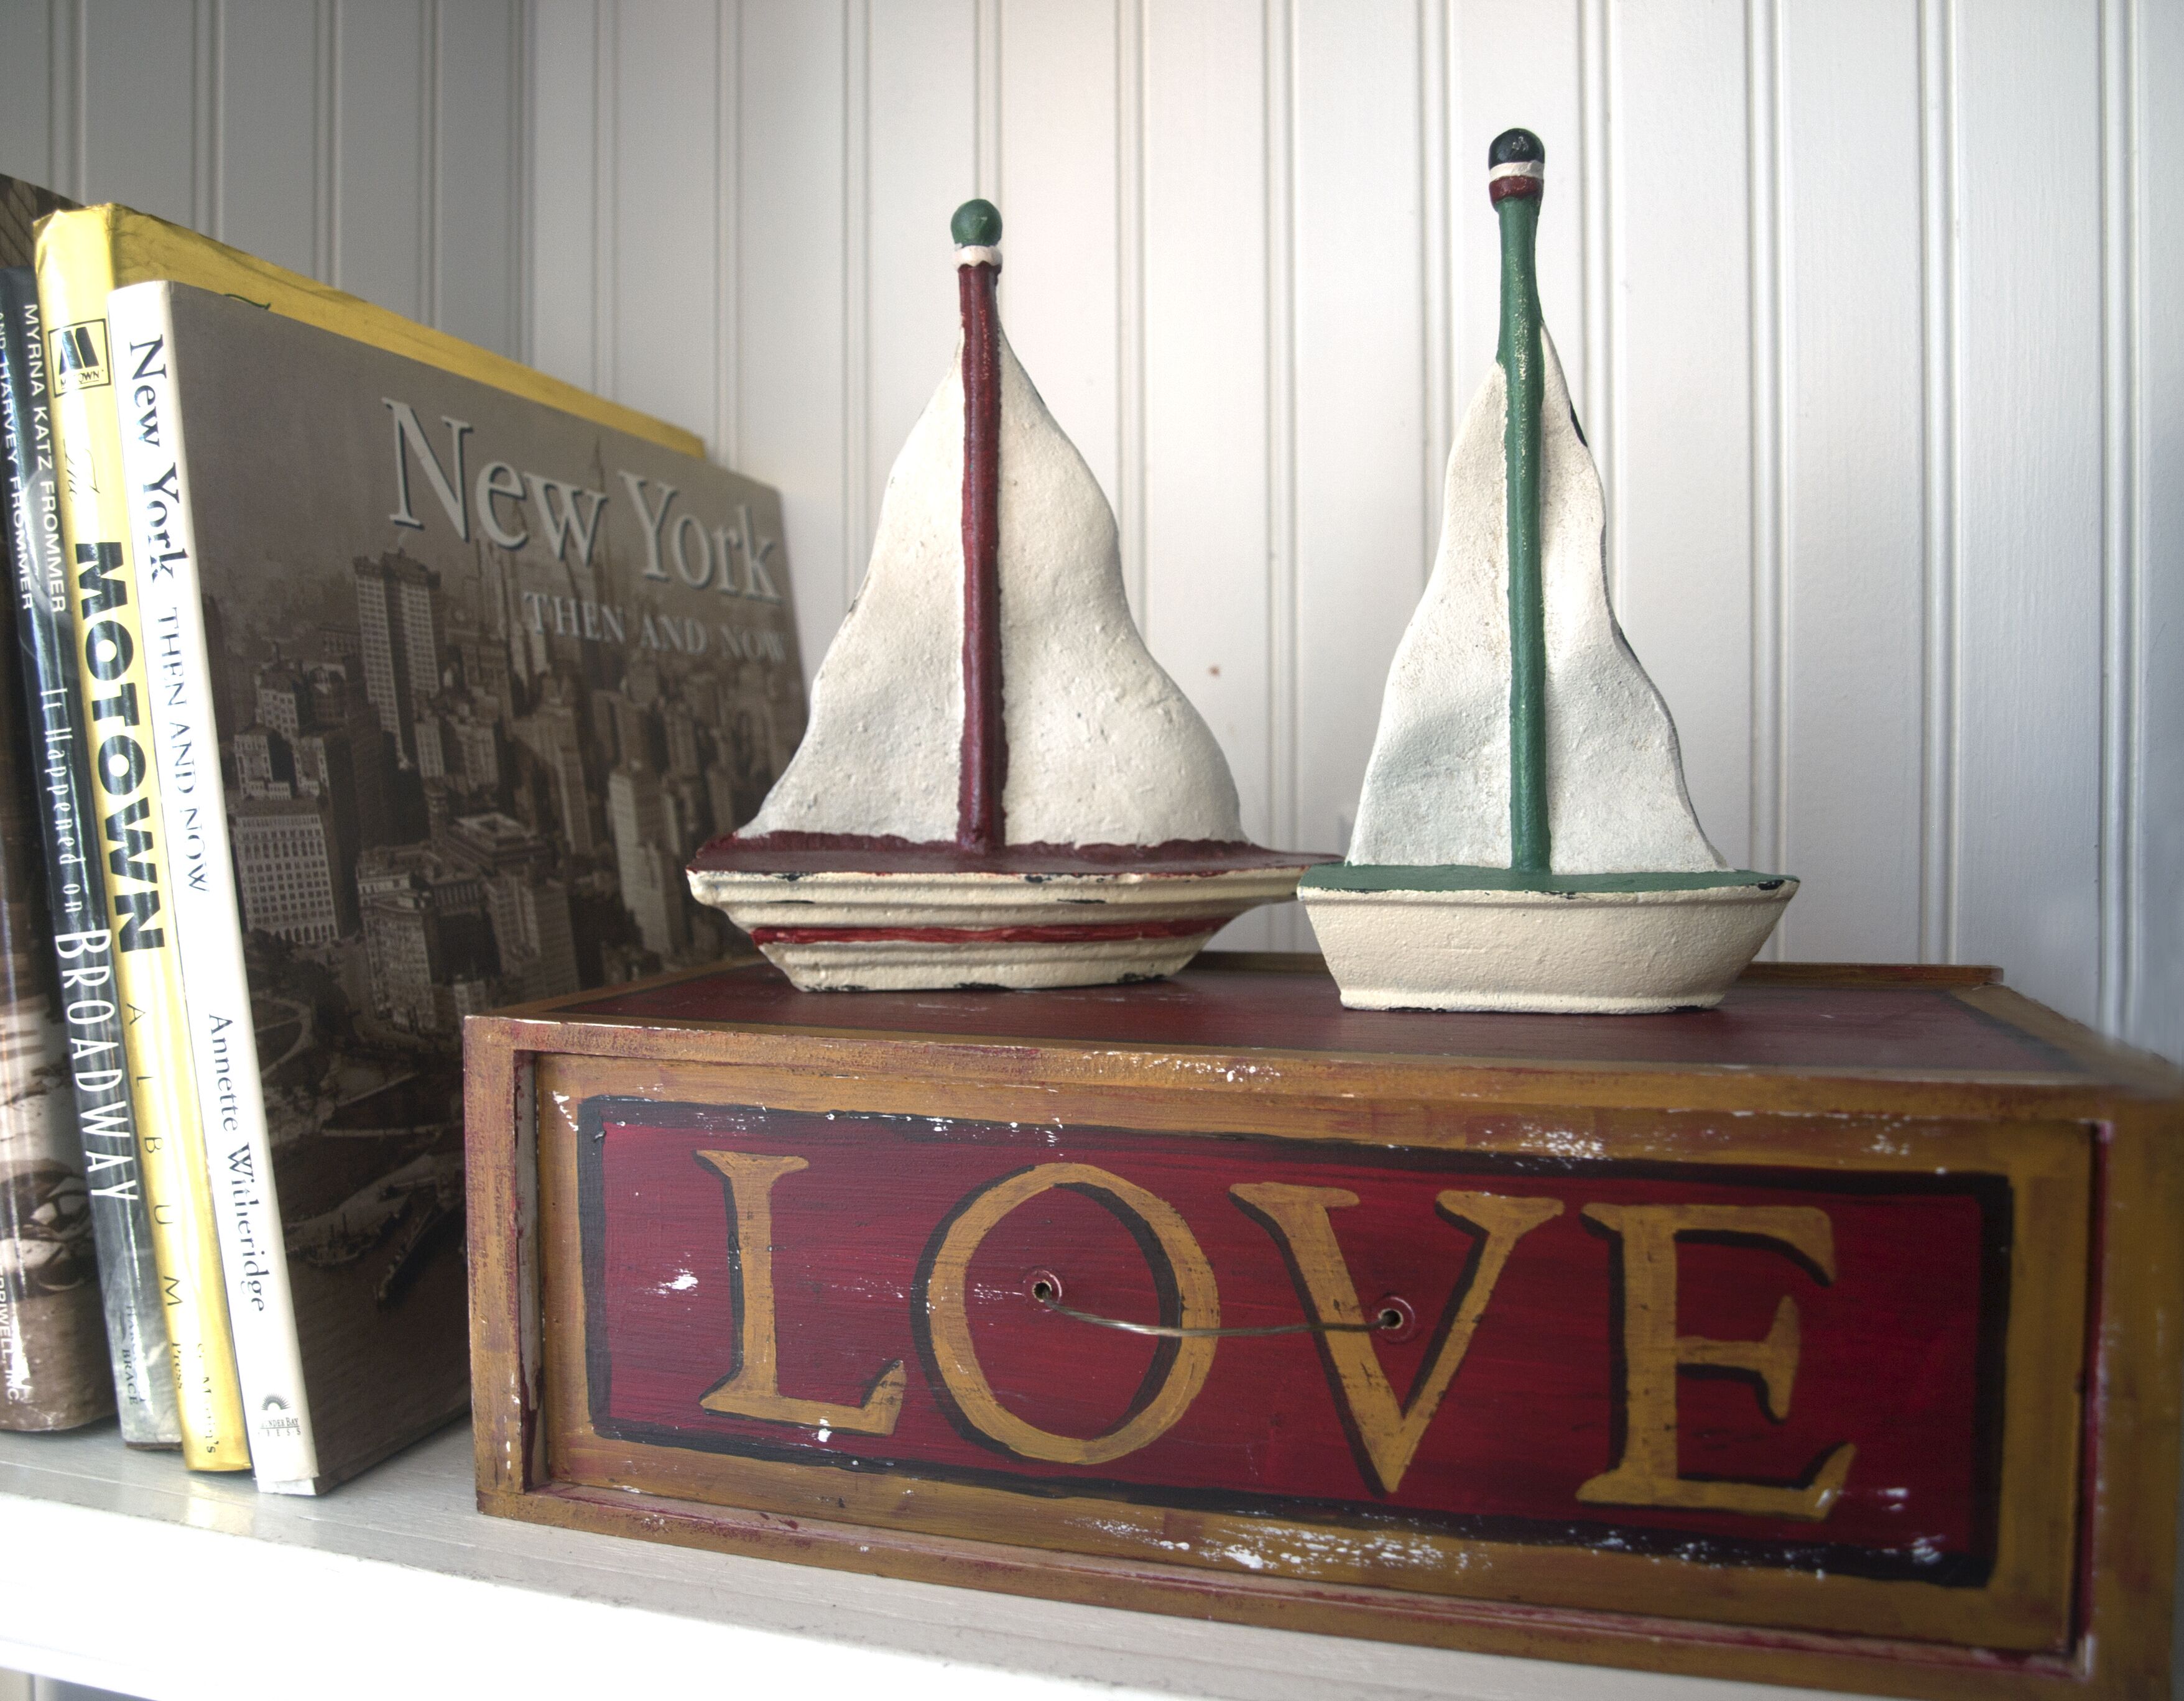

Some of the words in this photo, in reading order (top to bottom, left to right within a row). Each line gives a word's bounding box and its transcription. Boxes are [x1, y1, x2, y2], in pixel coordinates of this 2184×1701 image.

[24, 304, 45, 396] MYRNA
[129, 334, 167, 447] New
[33, 407, 52, 471] KATZ
[10, 476, 33, 610] FROMMER
[40, 481, 66, 612] FROMMER
[143, 462, 190, 583] York
[381, 397, 608, 568] New
[618, 469, 782, 604] York
[158, 607, 187, 706] THEN
[522, 591, 626, 644] THEN
[639, 612, 708, 656] AND
[720, 623, 787, 666] NOW
[40, 688, 68, 709] It
[75, 541, 165, 954] MOTOWN
[44, 727, 86, 865] Happened
[170, 722, 196, 794] AND
[63, 883, 83, 913] on
[180, 806, 210, 892] NOW
[54, 929, 139, 1200] BROADWAY
[208, 1013, 239, 1132] Annette
[227, 1141, 270, 1312] Witheridge
[122, 1349, 139, 1405] BRACE
[695, 1150, 1857, 1522] LOVE
